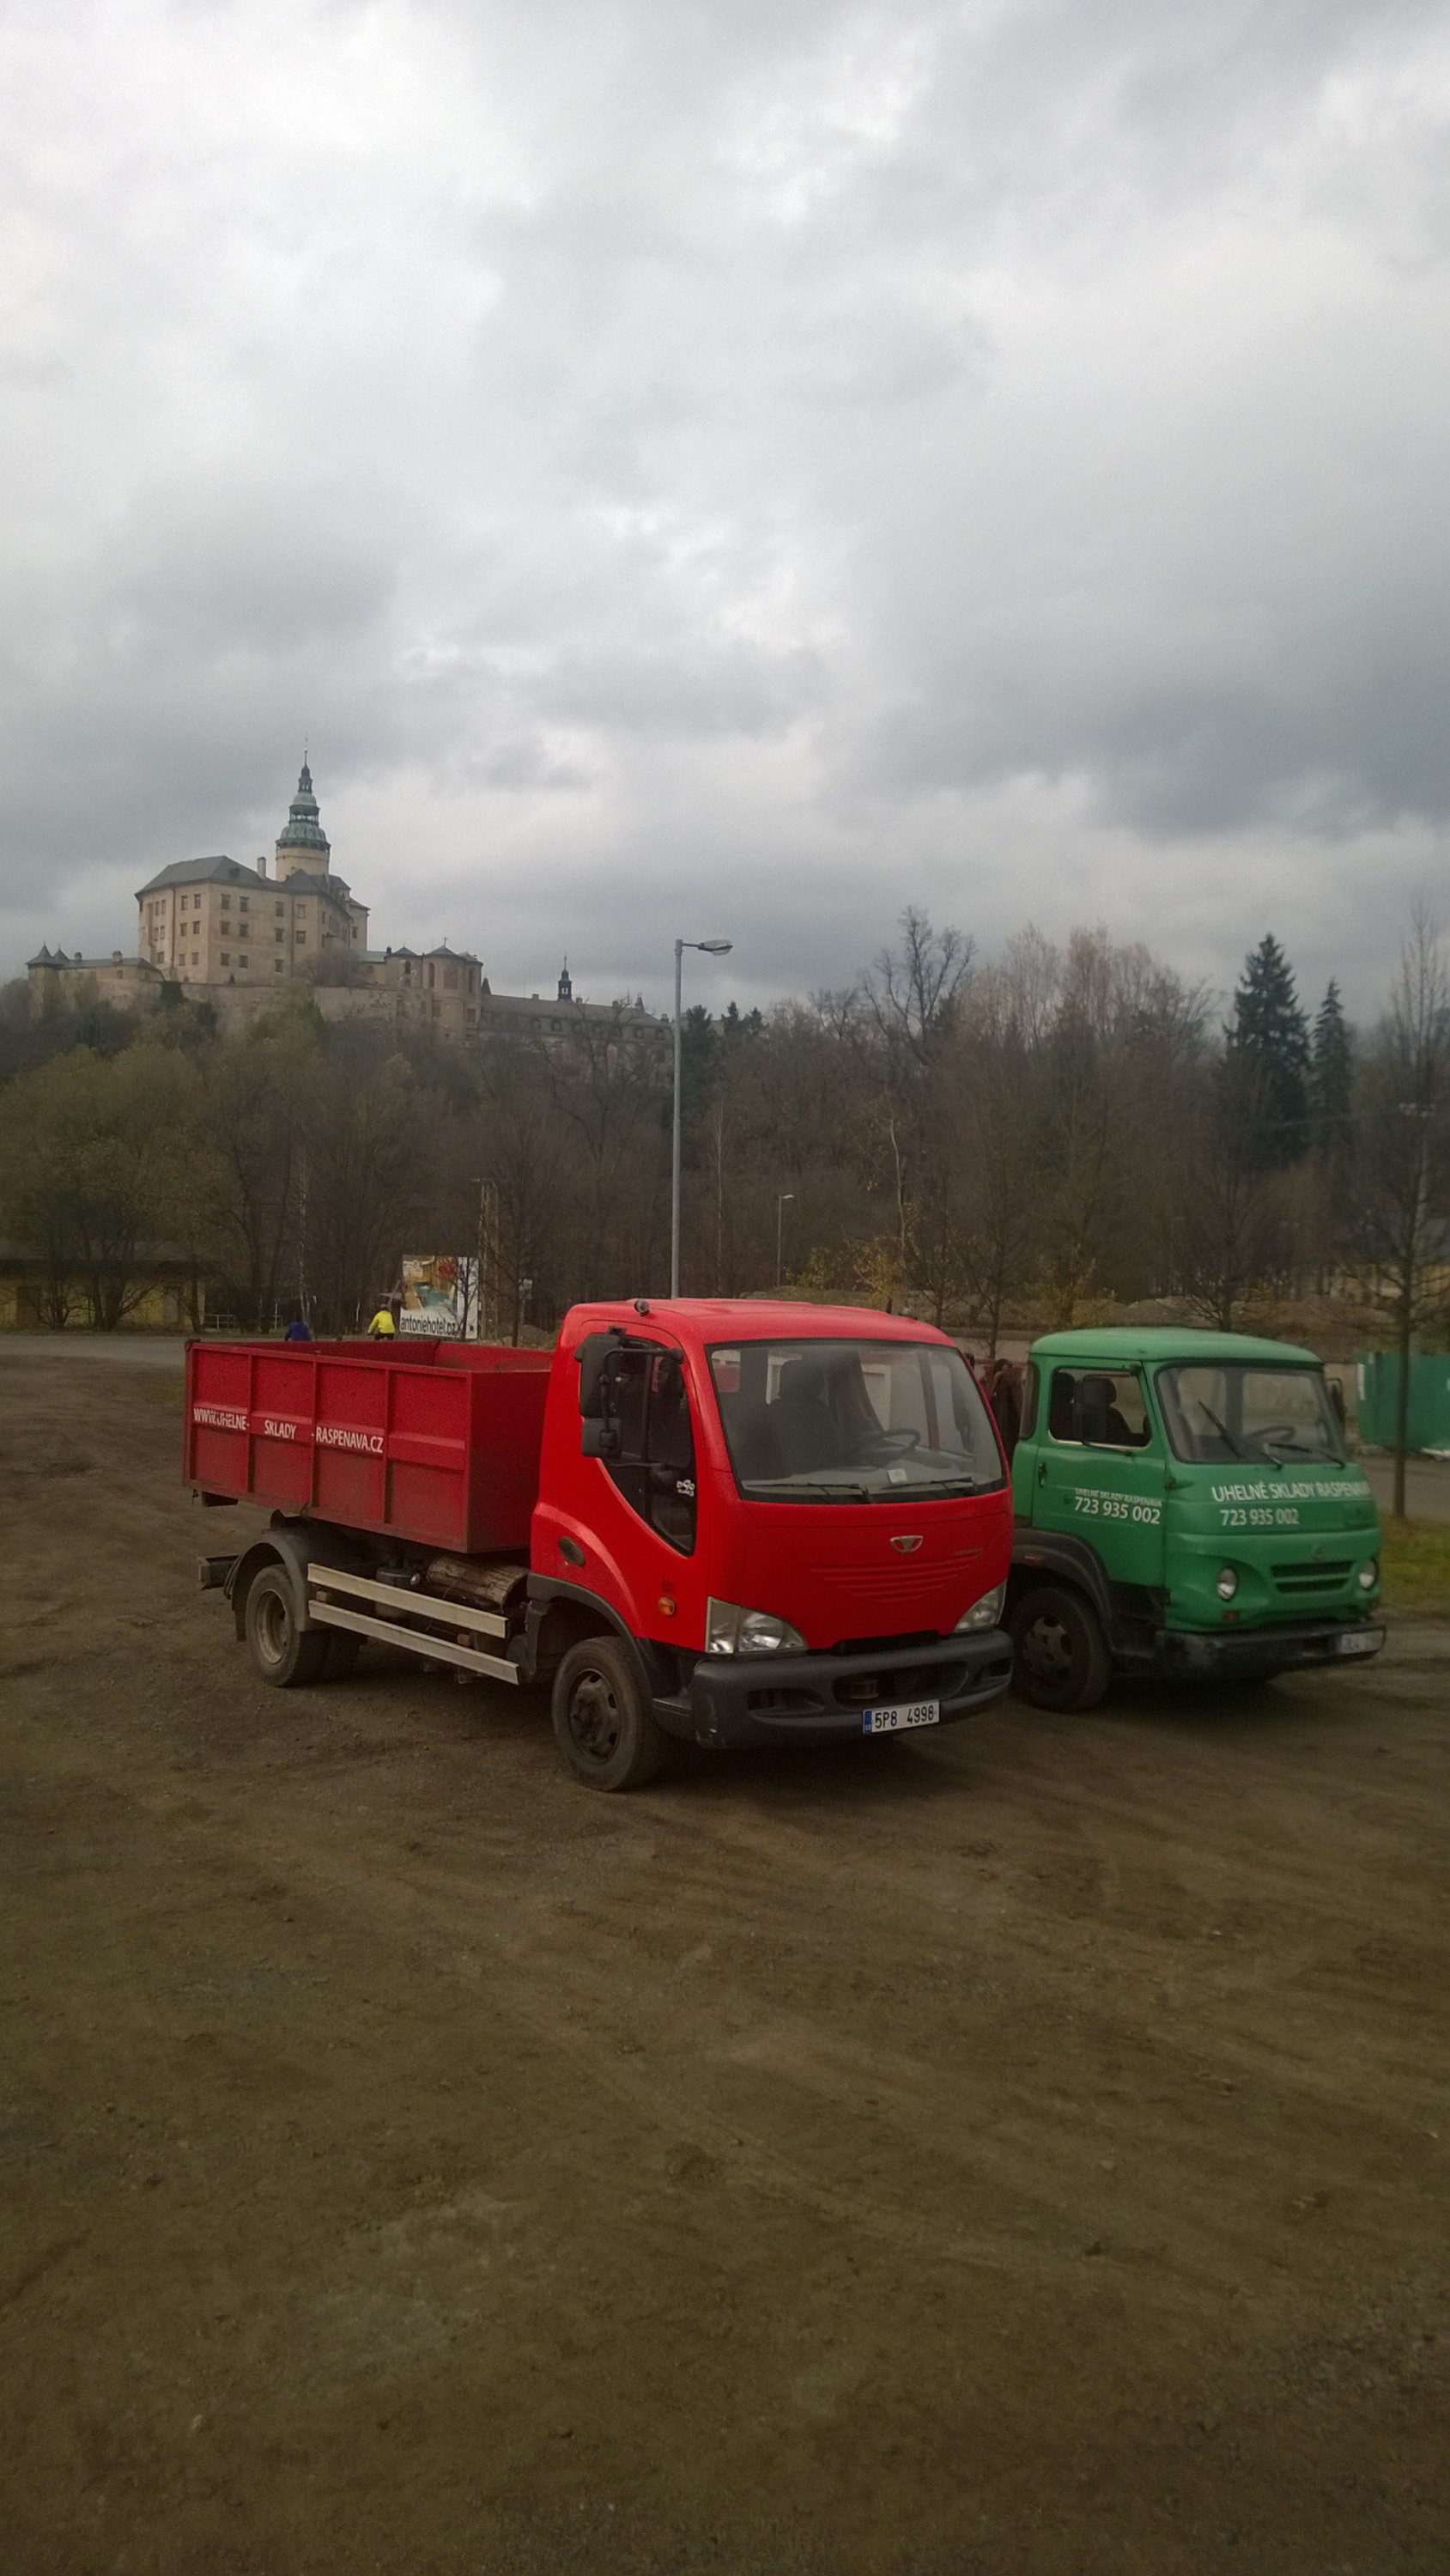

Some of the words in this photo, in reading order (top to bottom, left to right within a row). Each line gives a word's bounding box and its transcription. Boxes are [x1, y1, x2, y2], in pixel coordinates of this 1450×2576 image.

[264, 1419, 296, 1440] SKLADY
[1211, 1480, 1270, 1502] UHELNÉ
[1269, 1482, 1316, 1499] SKLADY
[1075, 1496, 1099, 1515] 723
[1103, 1501, 1130, 1519] 935
[1132, 1506, 1161, 1525] 002
[1220, 1509, 1247, 1527] 723
[1248, 1508, 1274, 1526] 935
[1275, 1507, 1301, 1525] 002
[875, 1710, 898, 1728] 5P8
[907, 1704, 934, 1724] 4998
